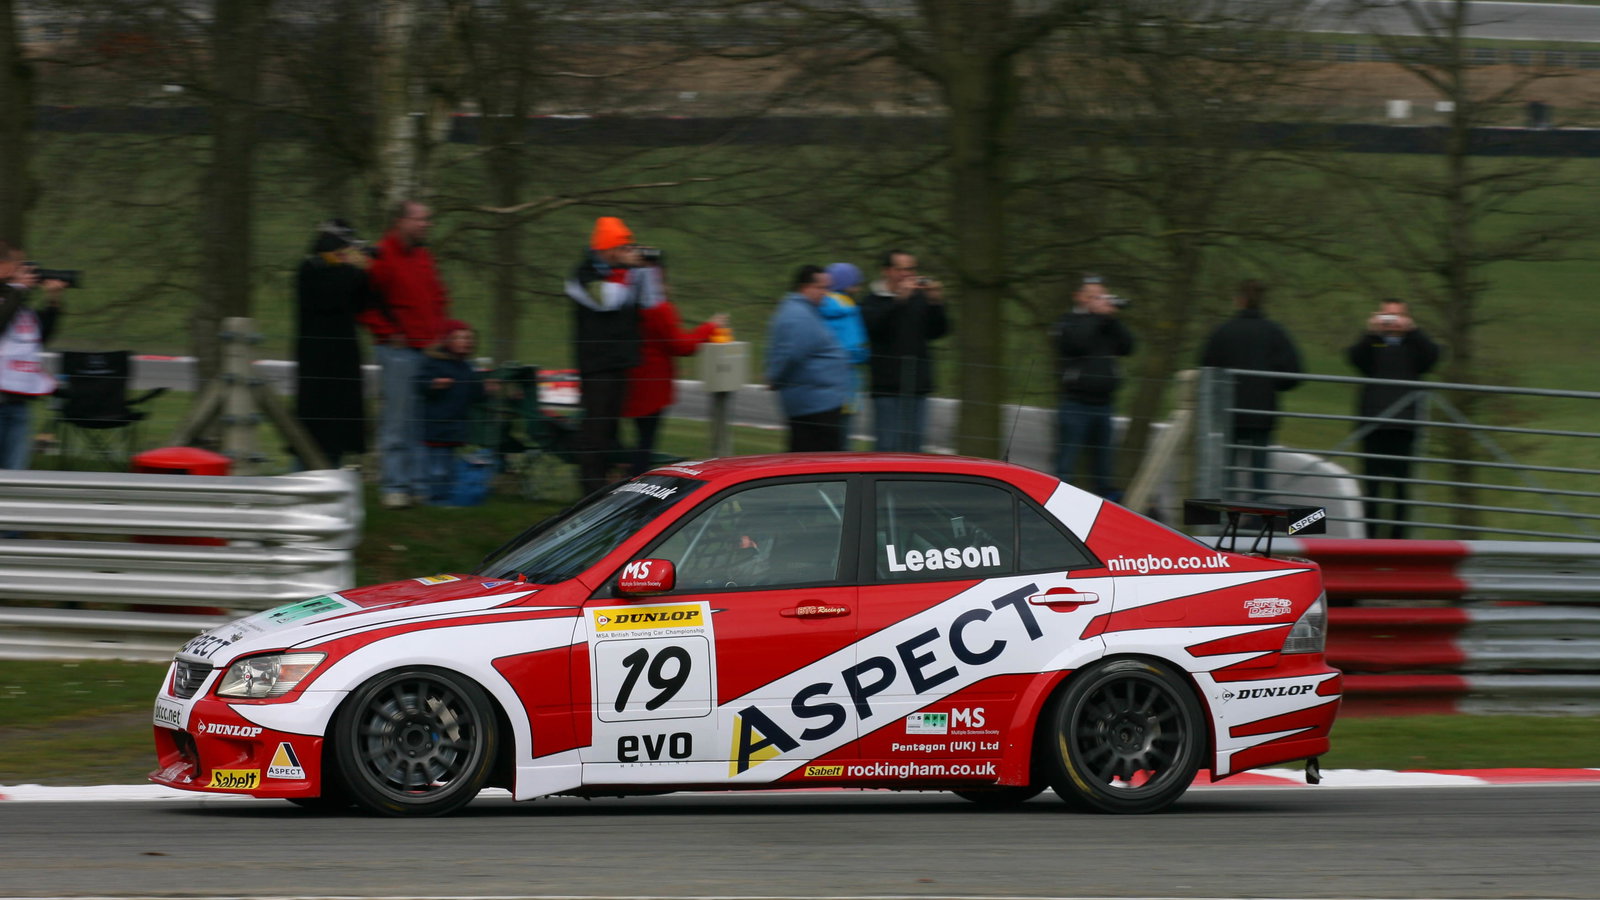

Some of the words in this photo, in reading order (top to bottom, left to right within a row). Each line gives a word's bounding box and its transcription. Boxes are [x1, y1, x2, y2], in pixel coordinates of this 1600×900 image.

[1289, 509, 1324, 534] ASPECT
[886, 545, 1001, 572] Leason
[1107, 553, 1230, 574] ningbo.co.uk
[622, 561, 652, 580] MS
[614, 610, 700, 624] DUNLOP
[817, 606, 841, 614] Racing
[614, 645, 692, 713] 19
[729, 583, 1044, 778] ASPECT
[1236, 684, 1313, 700] DUNLOP
[951, 707, 986, 729] MS
[206, 723, 262, 738] DUNLOP
[617, 732, 693, 763] evo
[950, 741, 976, 753] (UK)
[980, 741, 999, 751] Ltd
[214, 769, 257, 789] Sabelt
[268, 767, 301, 775] ASPECT
[807, 766, 841, 777] Sabelt
[847, 762, 996, 778] rockingham.co.uk
